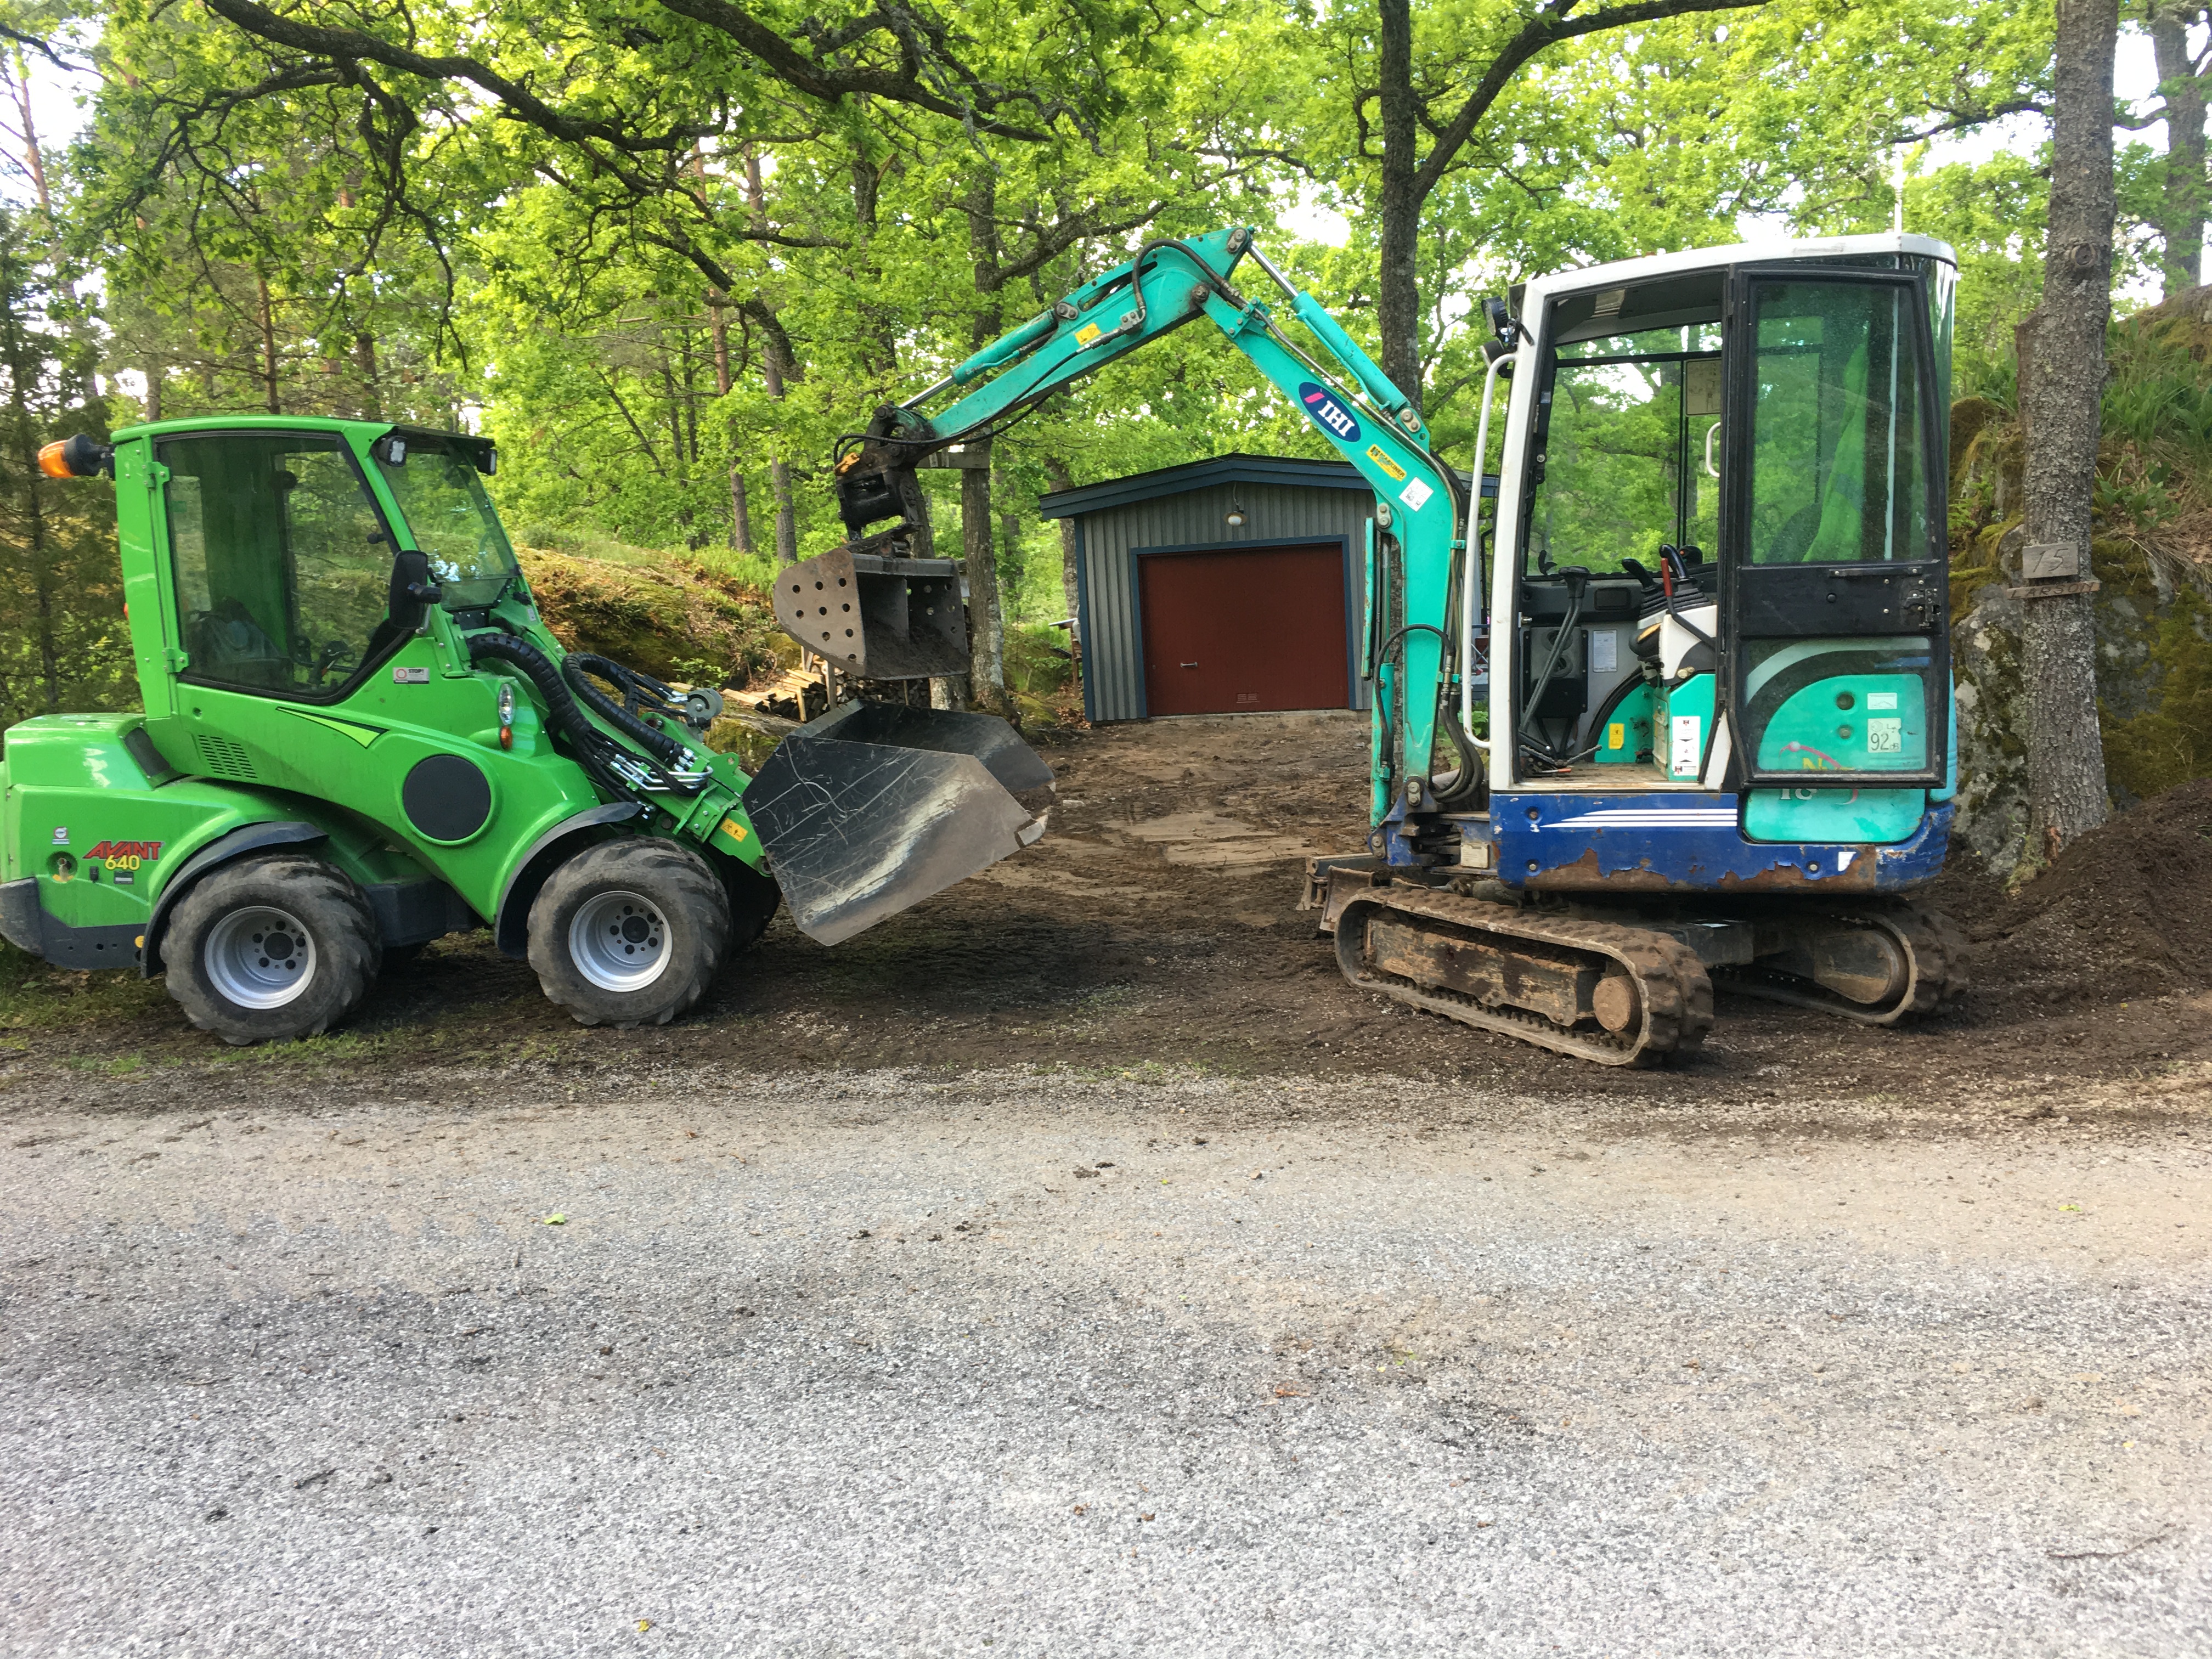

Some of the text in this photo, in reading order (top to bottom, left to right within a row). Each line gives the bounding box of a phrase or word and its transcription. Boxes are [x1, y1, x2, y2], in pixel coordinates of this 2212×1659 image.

[1317, 400, 1355, 437] IHI
[2032, 548, 2069, 573] 15
[2010, 583, 2095, 598] LARSON
[1870, 732, 1889, 751] 92
[82, 840, 162, 860] AVANT
[104, 854, 140, 871] 640
